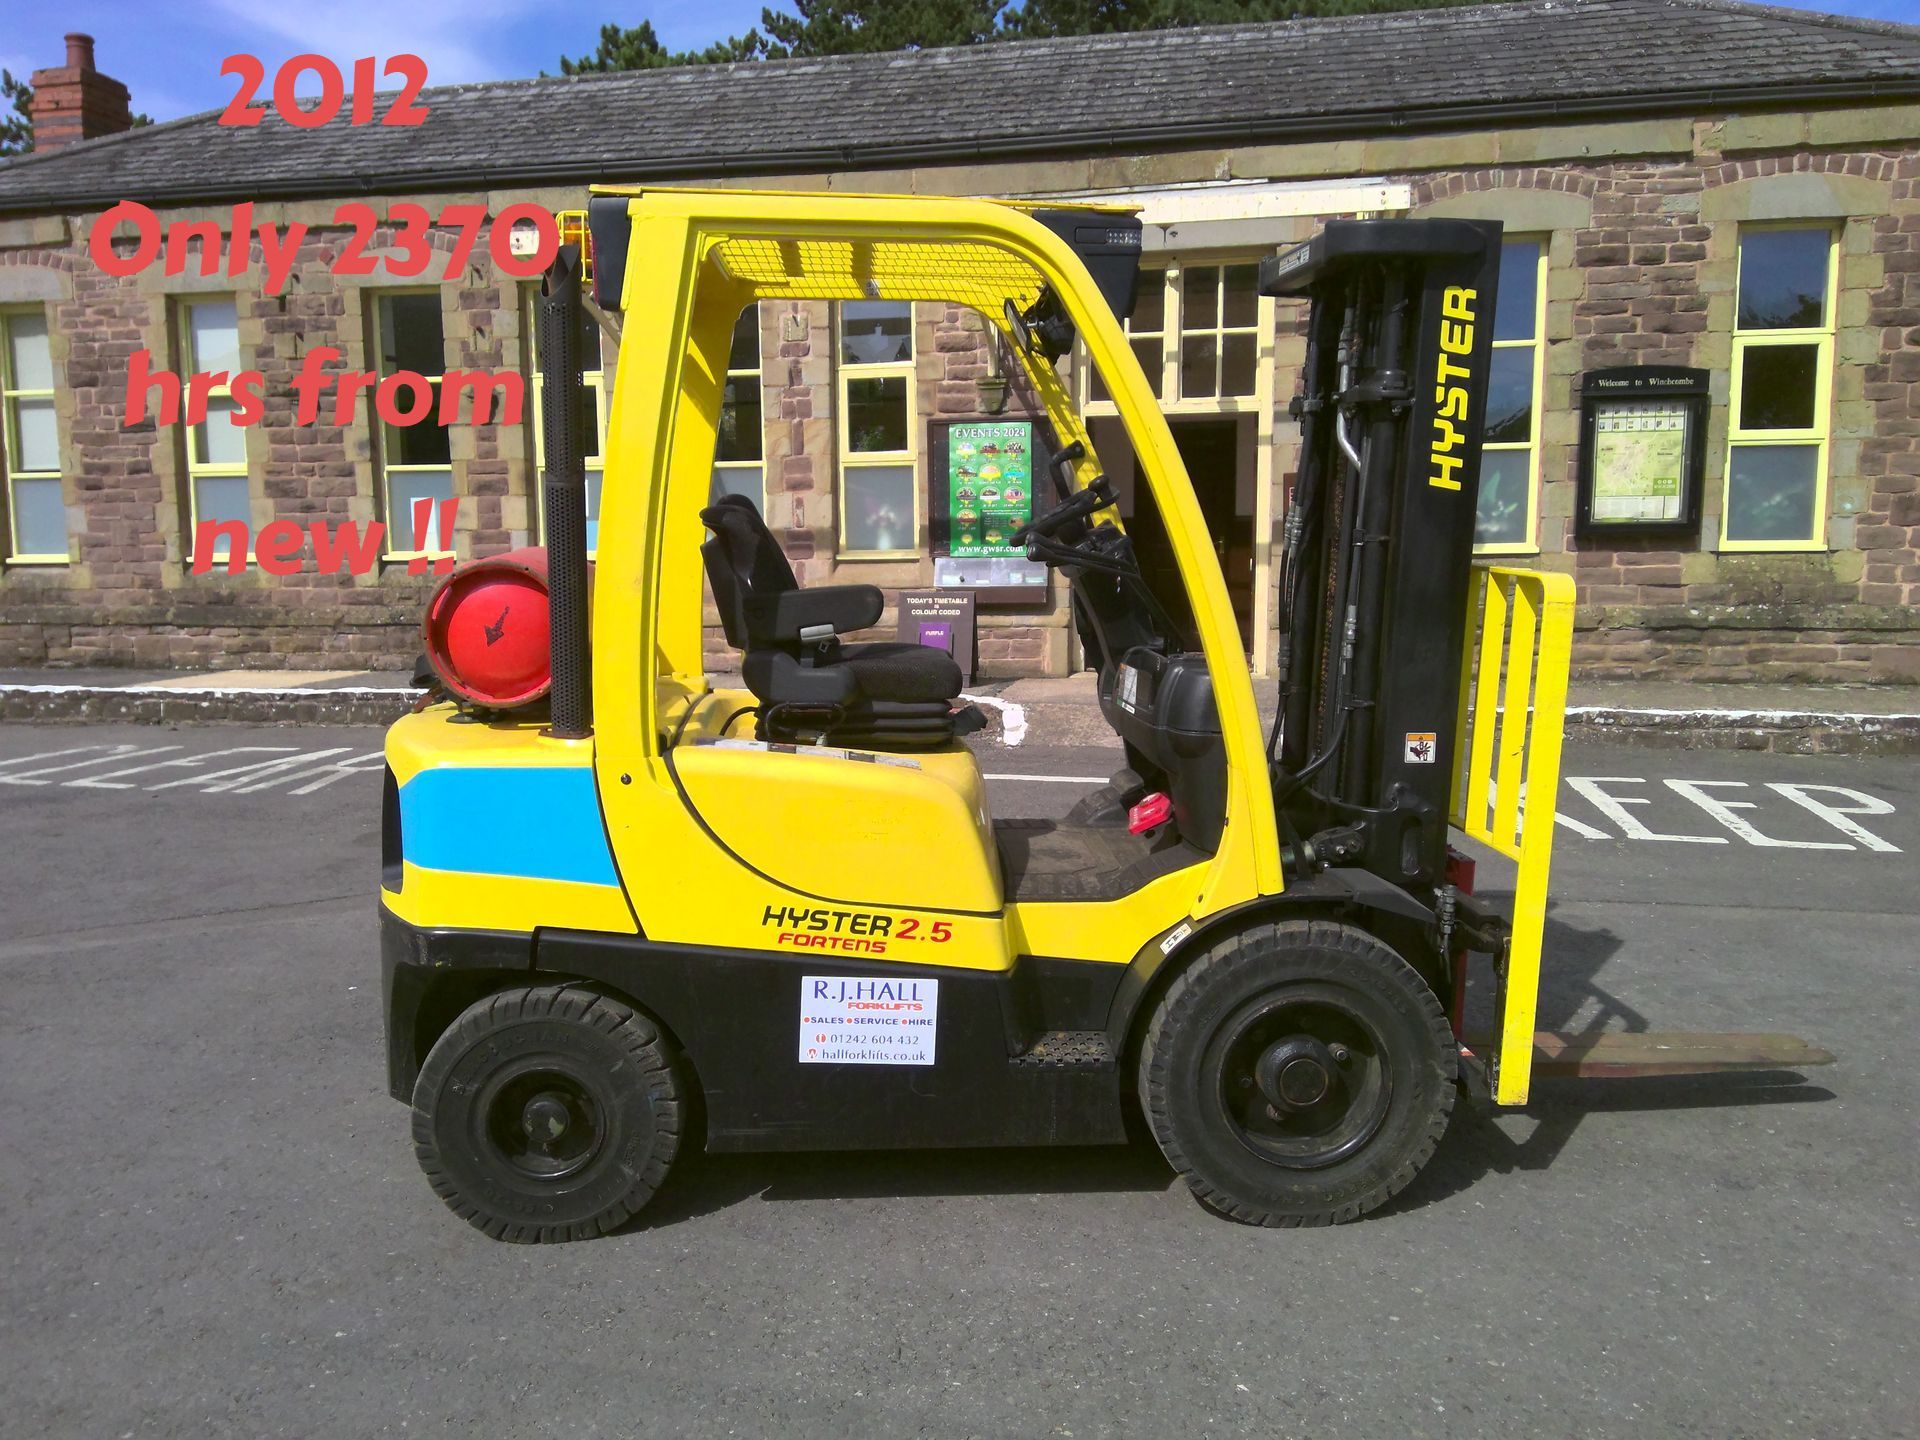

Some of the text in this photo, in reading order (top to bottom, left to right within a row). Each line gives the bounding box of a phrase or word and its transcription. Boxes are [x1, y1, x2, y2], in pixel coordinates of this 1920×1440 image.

[1598, 379, 1630, 387] Welcome
[1649, 377, 1694, 386] Winchcombe
[1429, 285, 1478, 491] HYSTER
[955, 427, 1025, 438] EVENTS 2024
[958, 545, 1024, 555] www.gwsr.com
[762, 905, 953, 942] HYSTER 2.5
[777, 932, 887, 953] FORTENS
[848, 1002, 923, 1011] FORKLIFTS
[811, 1016, 933, 1026] SALES SERVICE HIRE
[830, 1034, 919, 1045] 01242 604 432
[822, 1048, 926, 1061] hallforklifts.co.uk
